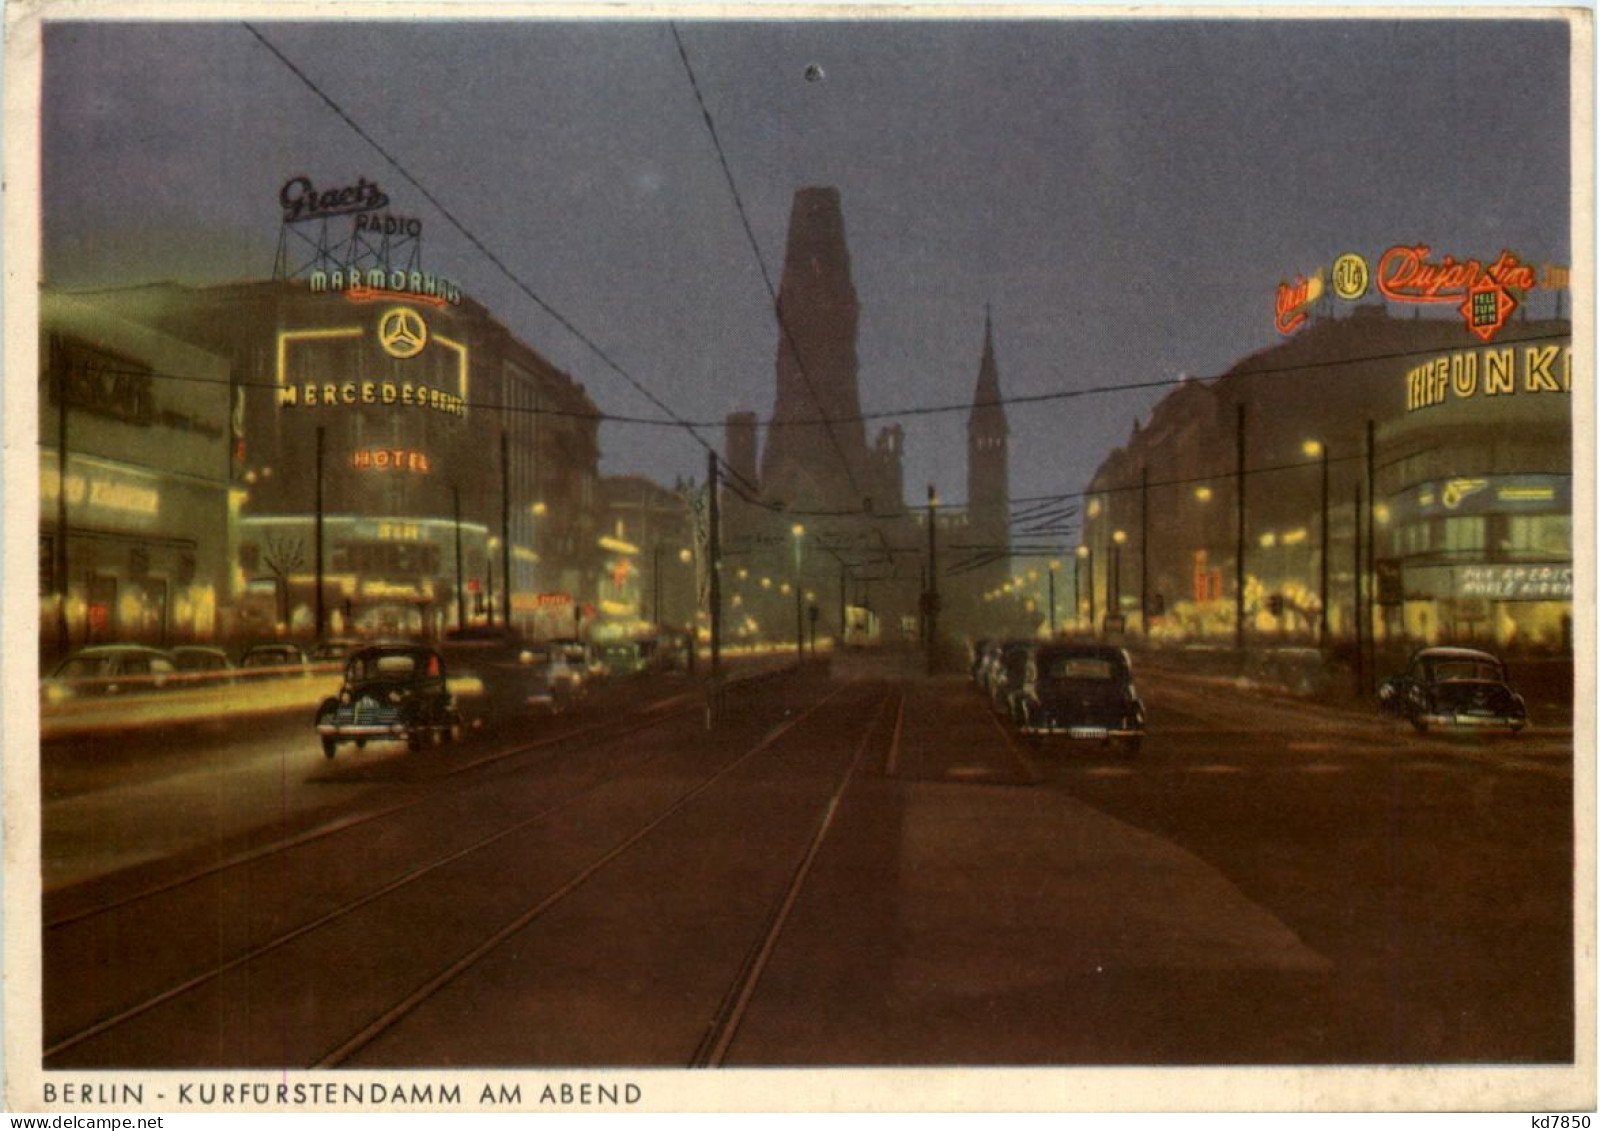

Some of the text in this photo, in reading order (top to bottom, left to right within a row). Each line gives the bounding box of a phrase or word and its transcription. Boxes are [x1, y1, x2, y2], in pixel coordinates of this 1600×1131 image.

[280, 176, 390, 222] Graetz
[355, 214, 422, 237] RADIO
[310, 268, 462, 306] MARMORHAUS
[352, 449, 431, 475] HOTEL
[45, 1084, 142, 1103] BERLIN
[180, 1083, 461, 1103] KURFÜRSTENDAMM
[479, 1084, 521, 1103] AM
[541, 1084, 641, 1103] ABEND
